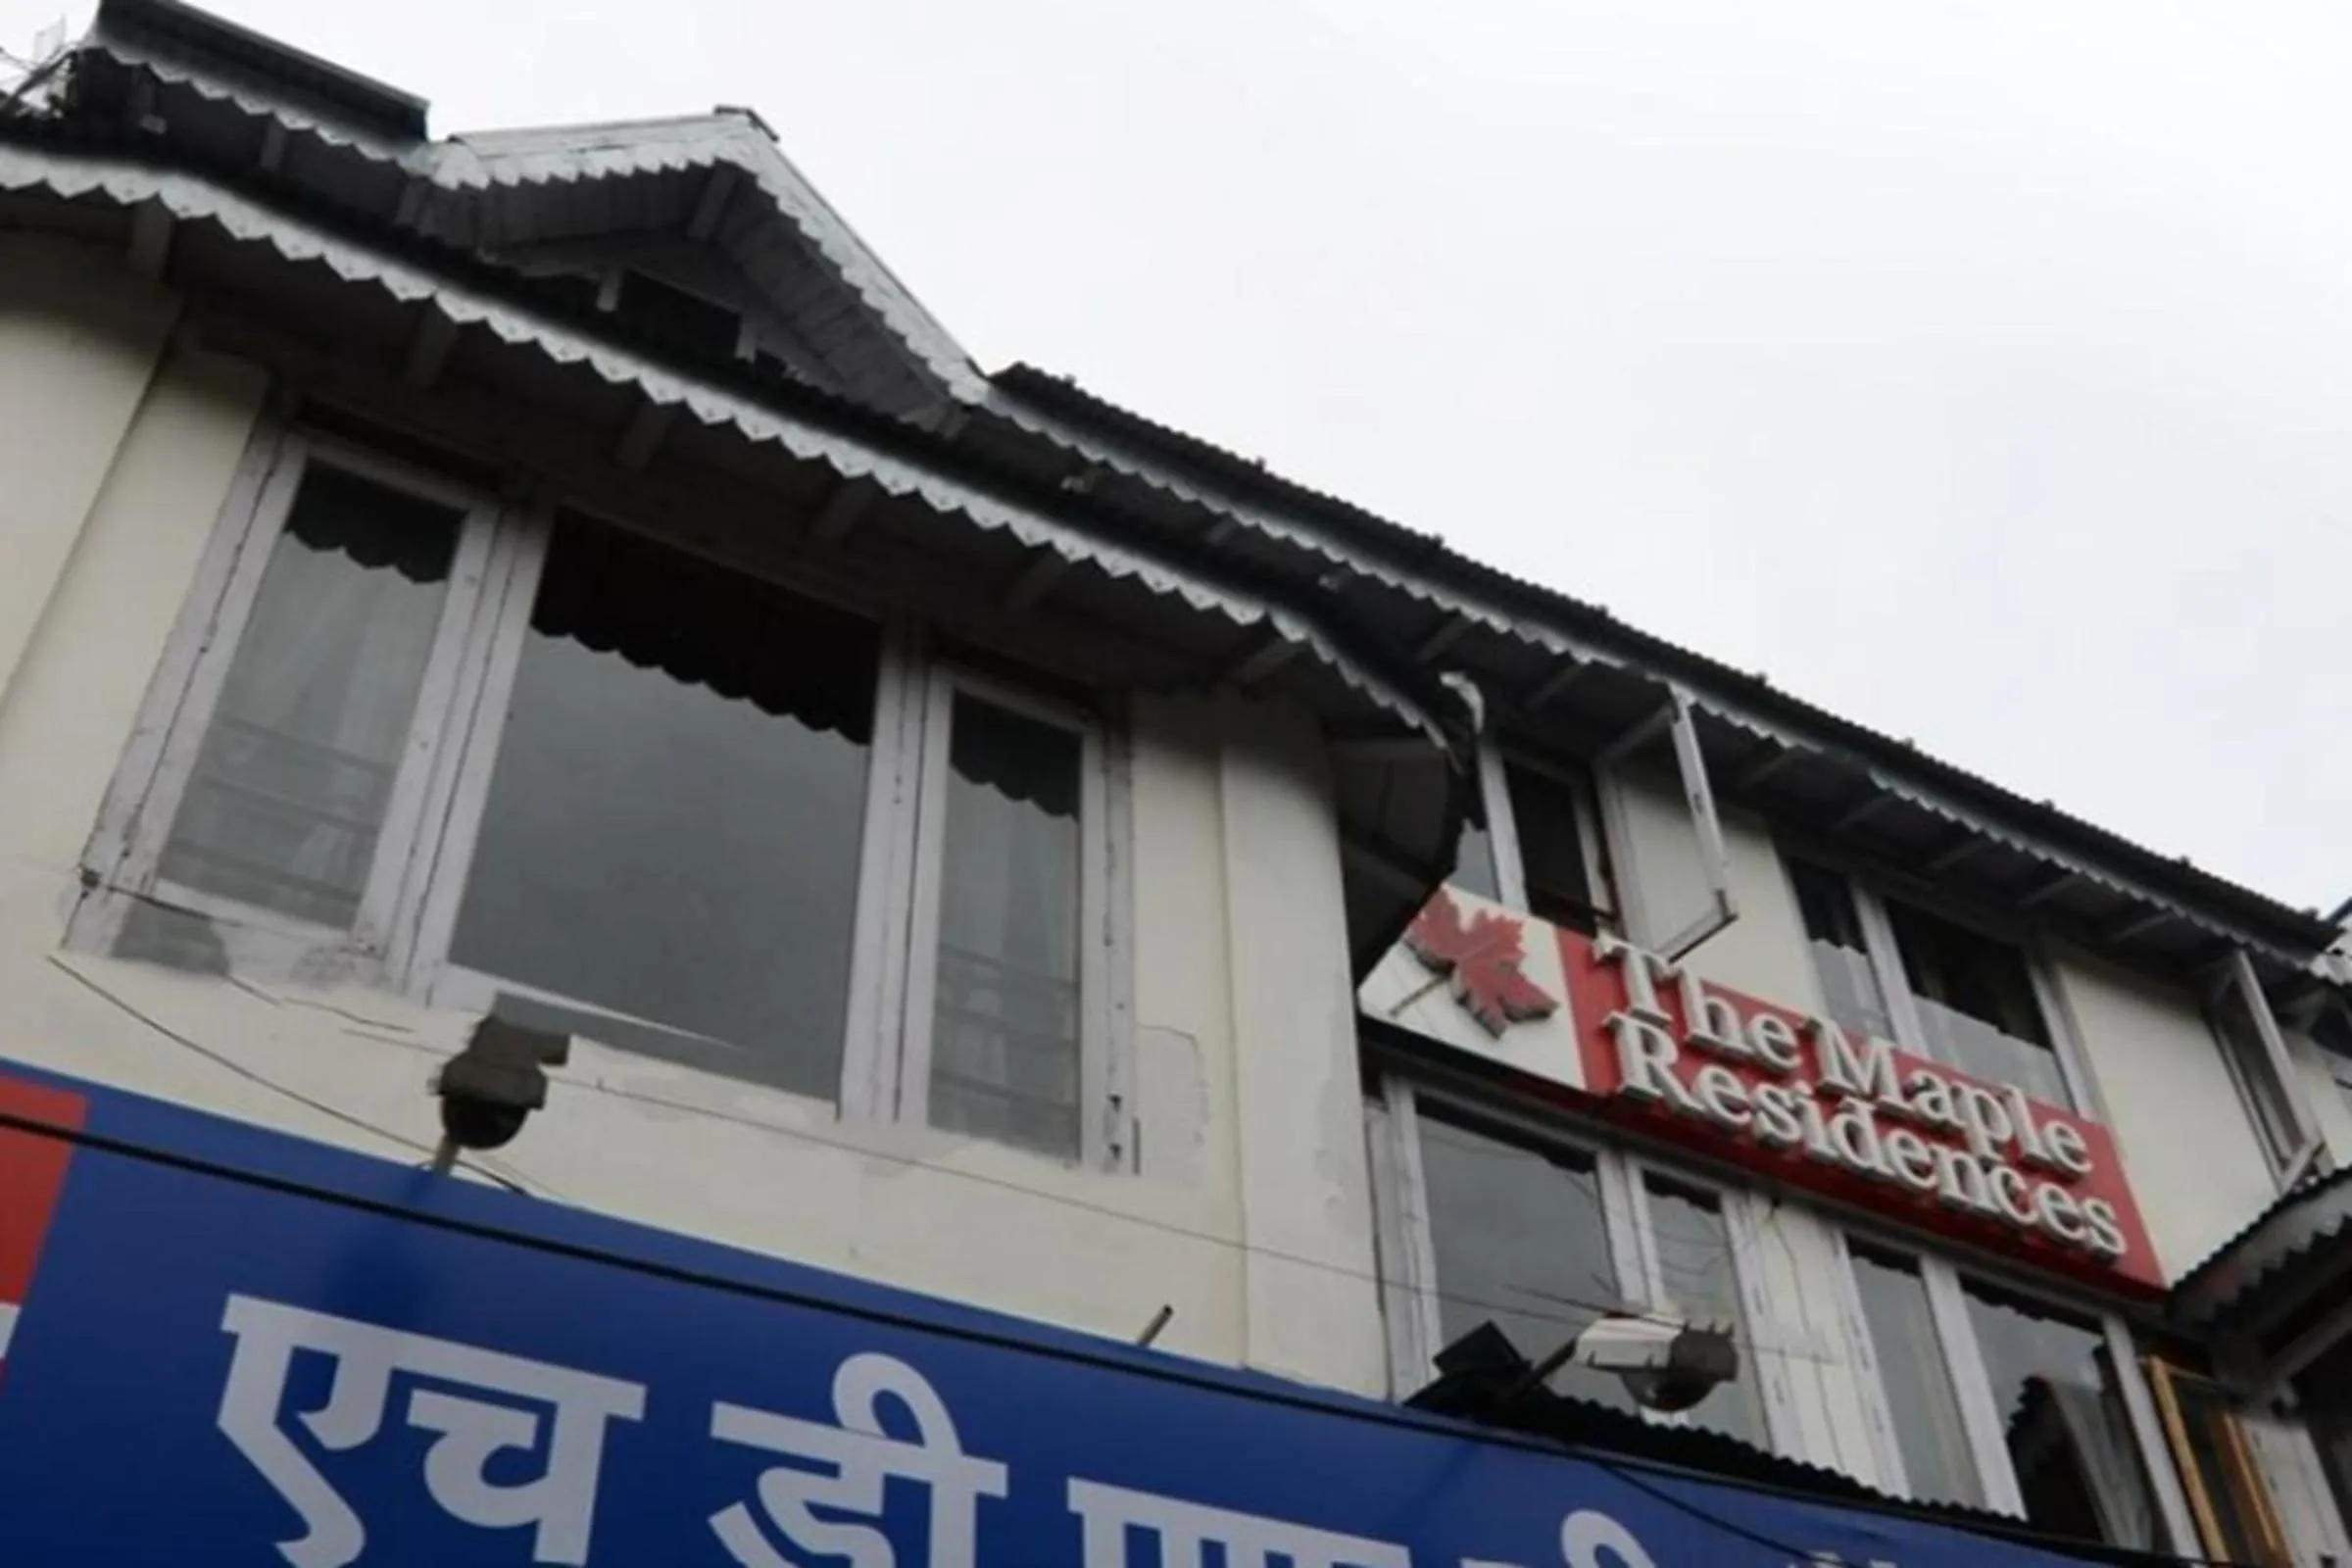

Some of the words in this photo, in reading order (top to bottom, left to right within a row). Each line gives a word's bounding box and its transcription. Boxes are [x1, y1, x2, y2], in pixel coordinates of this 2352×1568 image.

[1593, 933, 1802, 1070] The
[1800, 1017, 2093, 1178] Maple
[1604, 1012, 2129, 1259] Residences
[216, 1293, 648, 1568] एच
